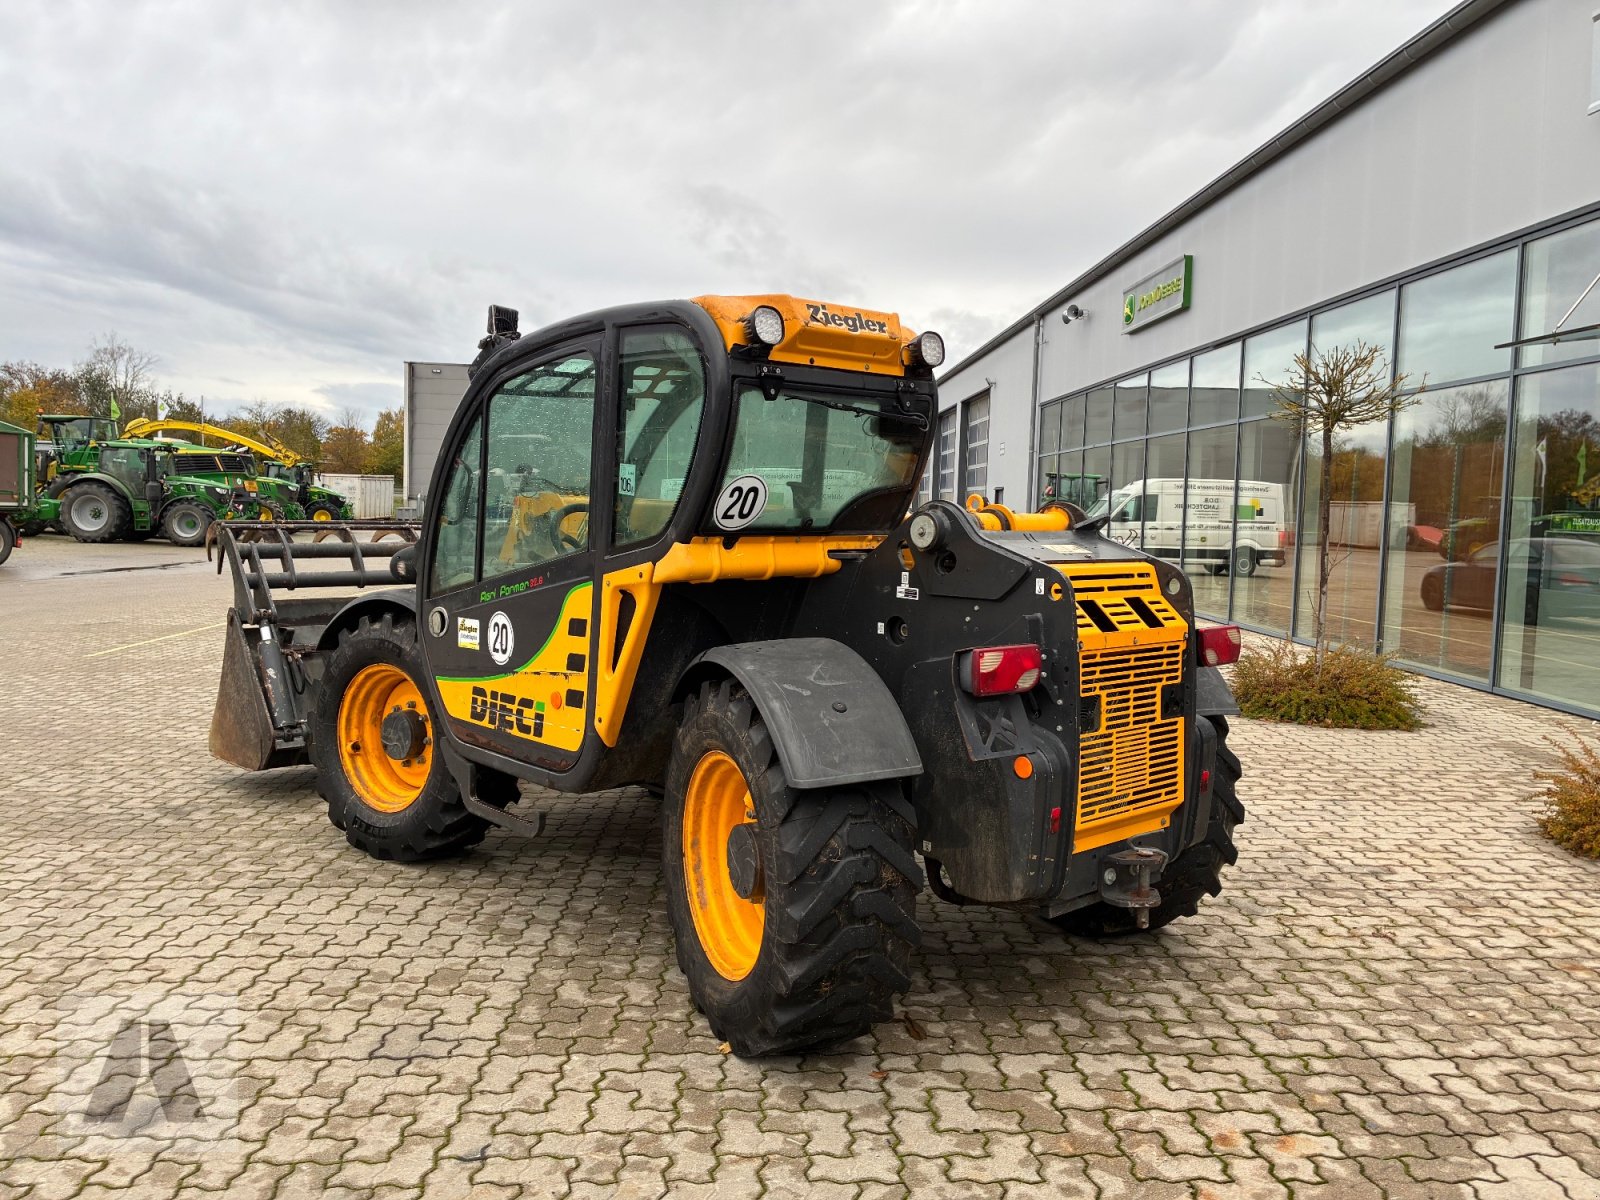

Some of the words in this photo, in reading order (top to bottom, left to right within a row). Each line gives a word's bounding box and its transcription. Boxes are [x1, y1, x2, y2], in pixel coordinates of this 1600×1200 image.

[806, 303, 887, 333] Ziegler
[721, 486, 759, 519] 20
[480, 588, 497, 602] Agri
[493, 622, 509, 655] 20
[470, 686, 545, 738] DIECI
